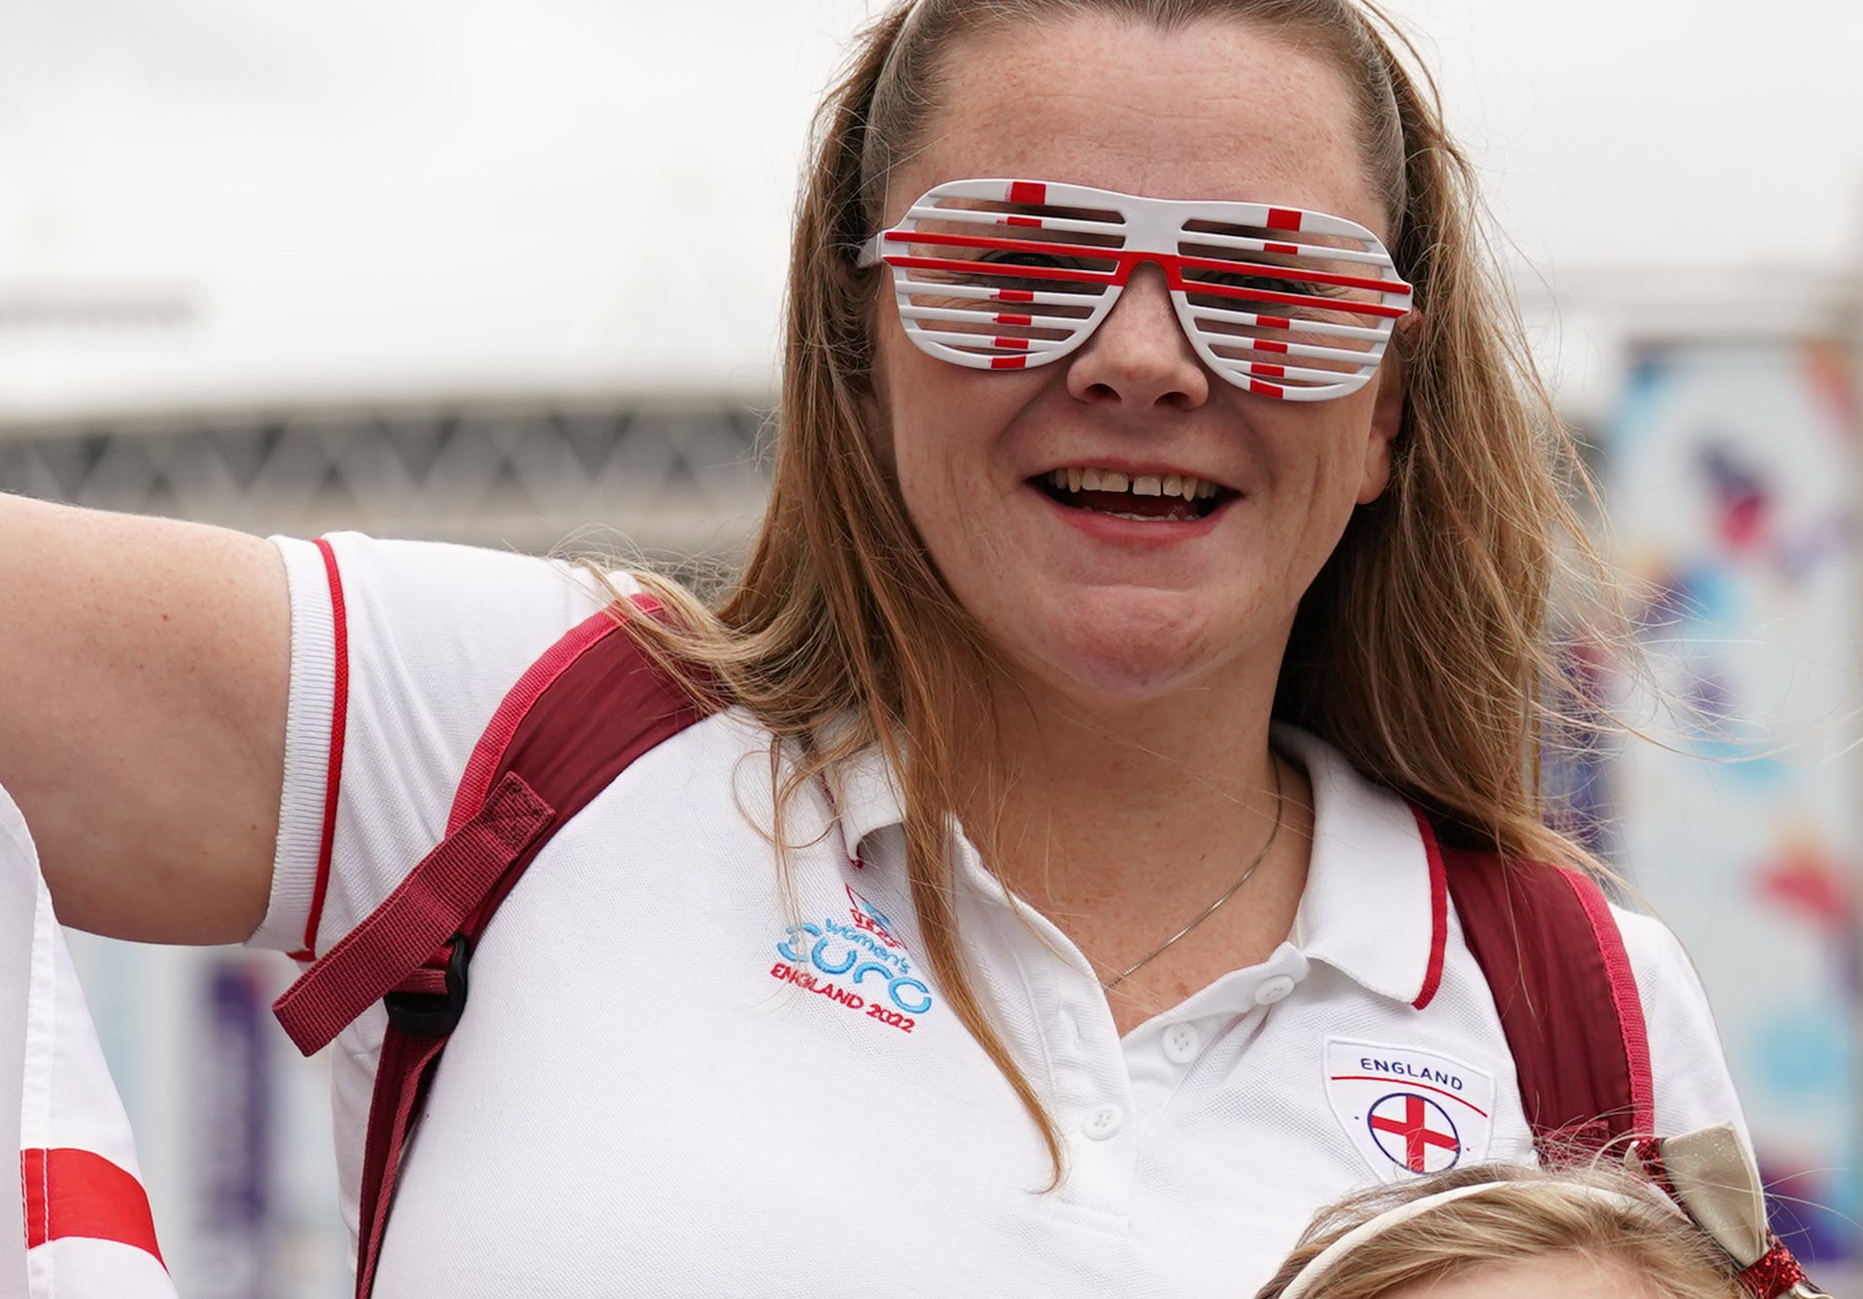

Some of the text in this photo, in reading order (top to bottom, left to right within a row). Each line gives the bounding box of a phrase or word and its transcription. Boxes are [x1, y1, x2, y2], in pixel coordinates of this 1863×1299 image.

[770, 962, 916, 1034] ENGLAND 2022
[1360, 1057, 1464, 1091] ENGLAND
